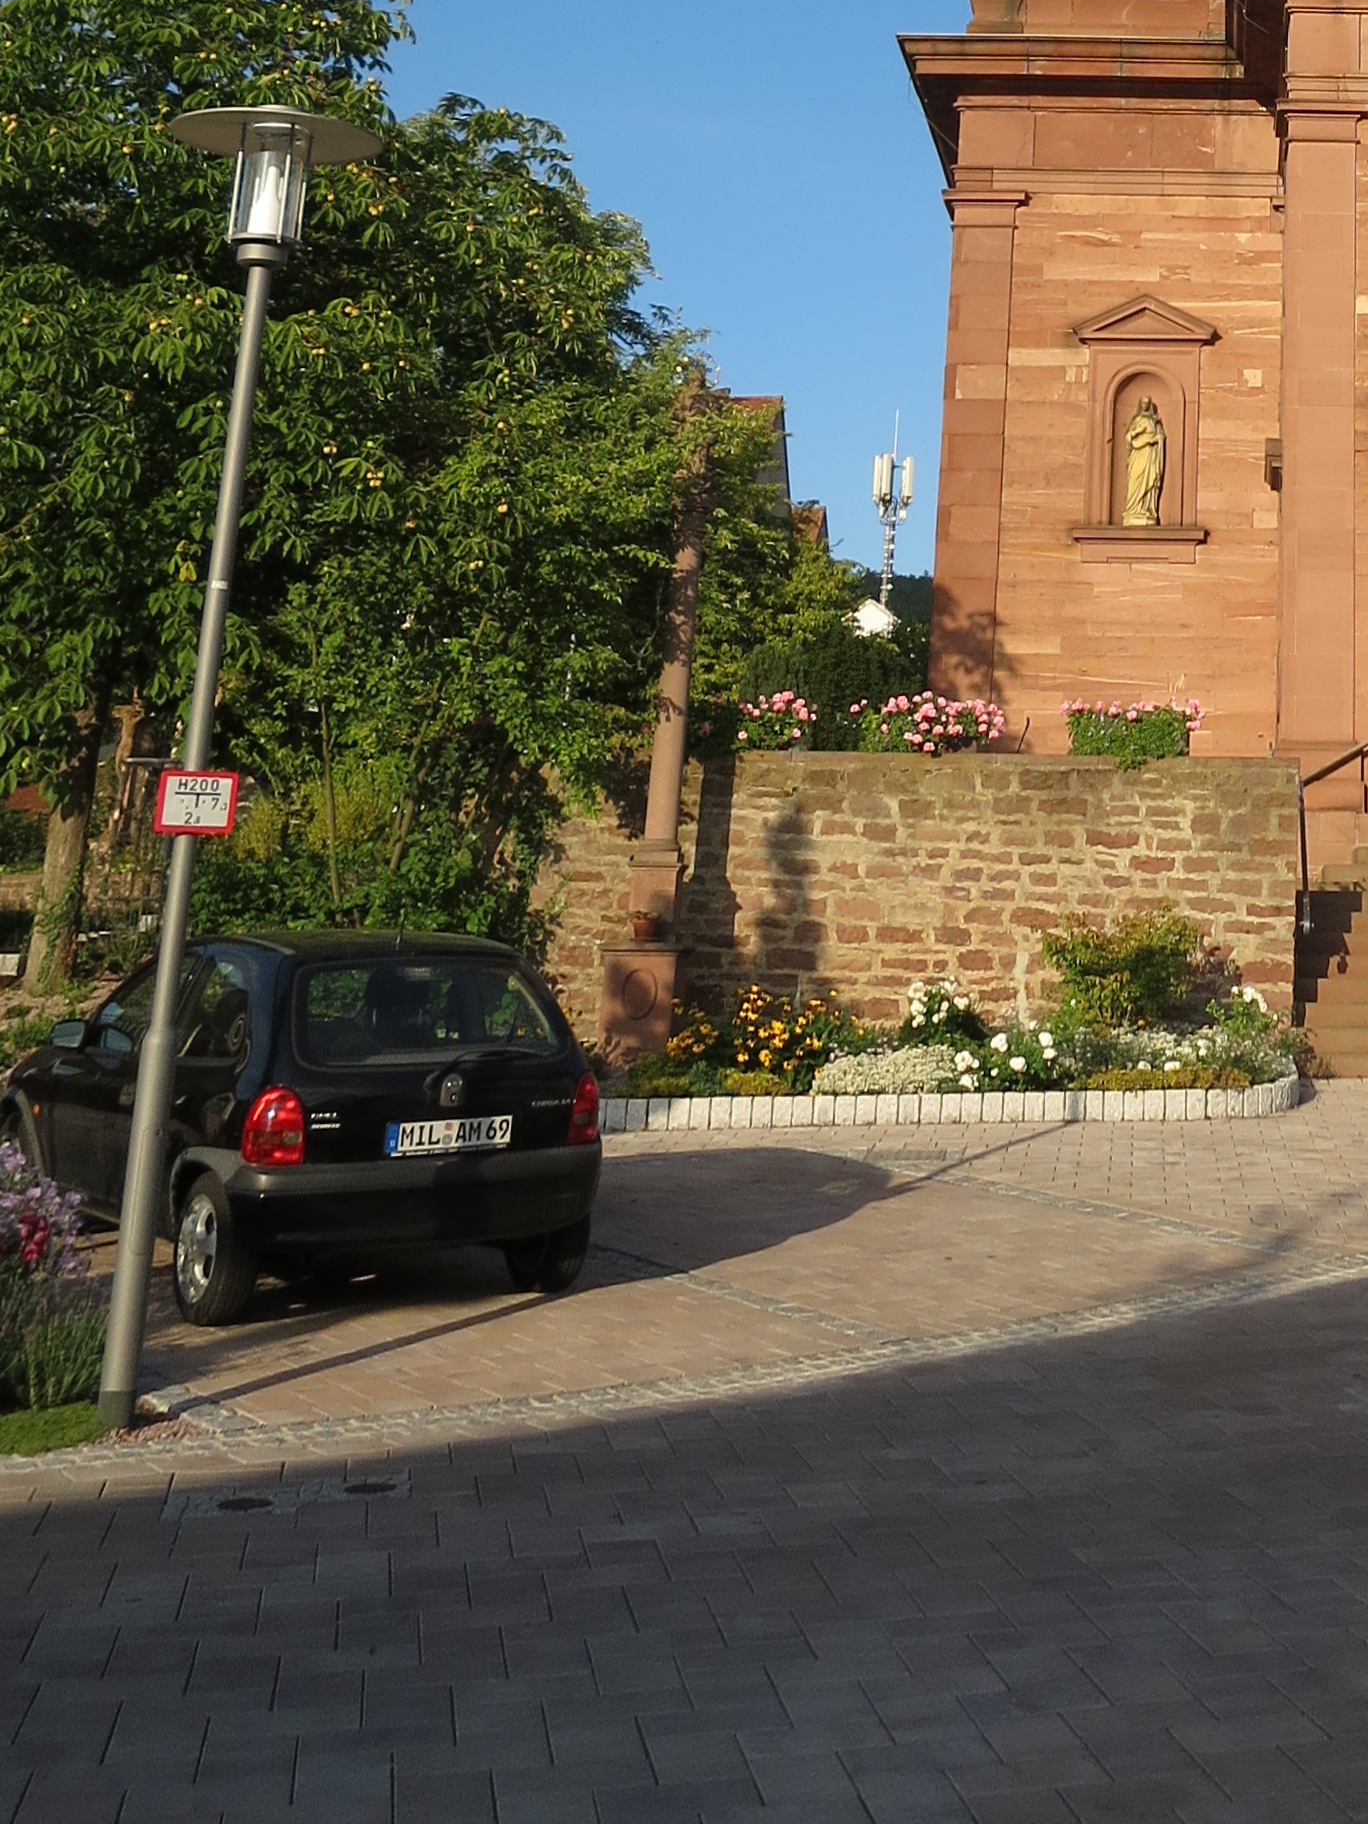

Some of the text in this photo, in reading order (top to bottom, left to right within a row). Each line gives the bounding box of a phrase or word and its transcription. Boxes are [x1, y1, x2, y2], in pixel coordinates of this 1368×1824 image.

[178, 778, 220, 792] H200
[400, 1124, 441, 1147] MIL
[455, 1121, 482, 1143] AM
[486, 1118, 510, 1140] 69
